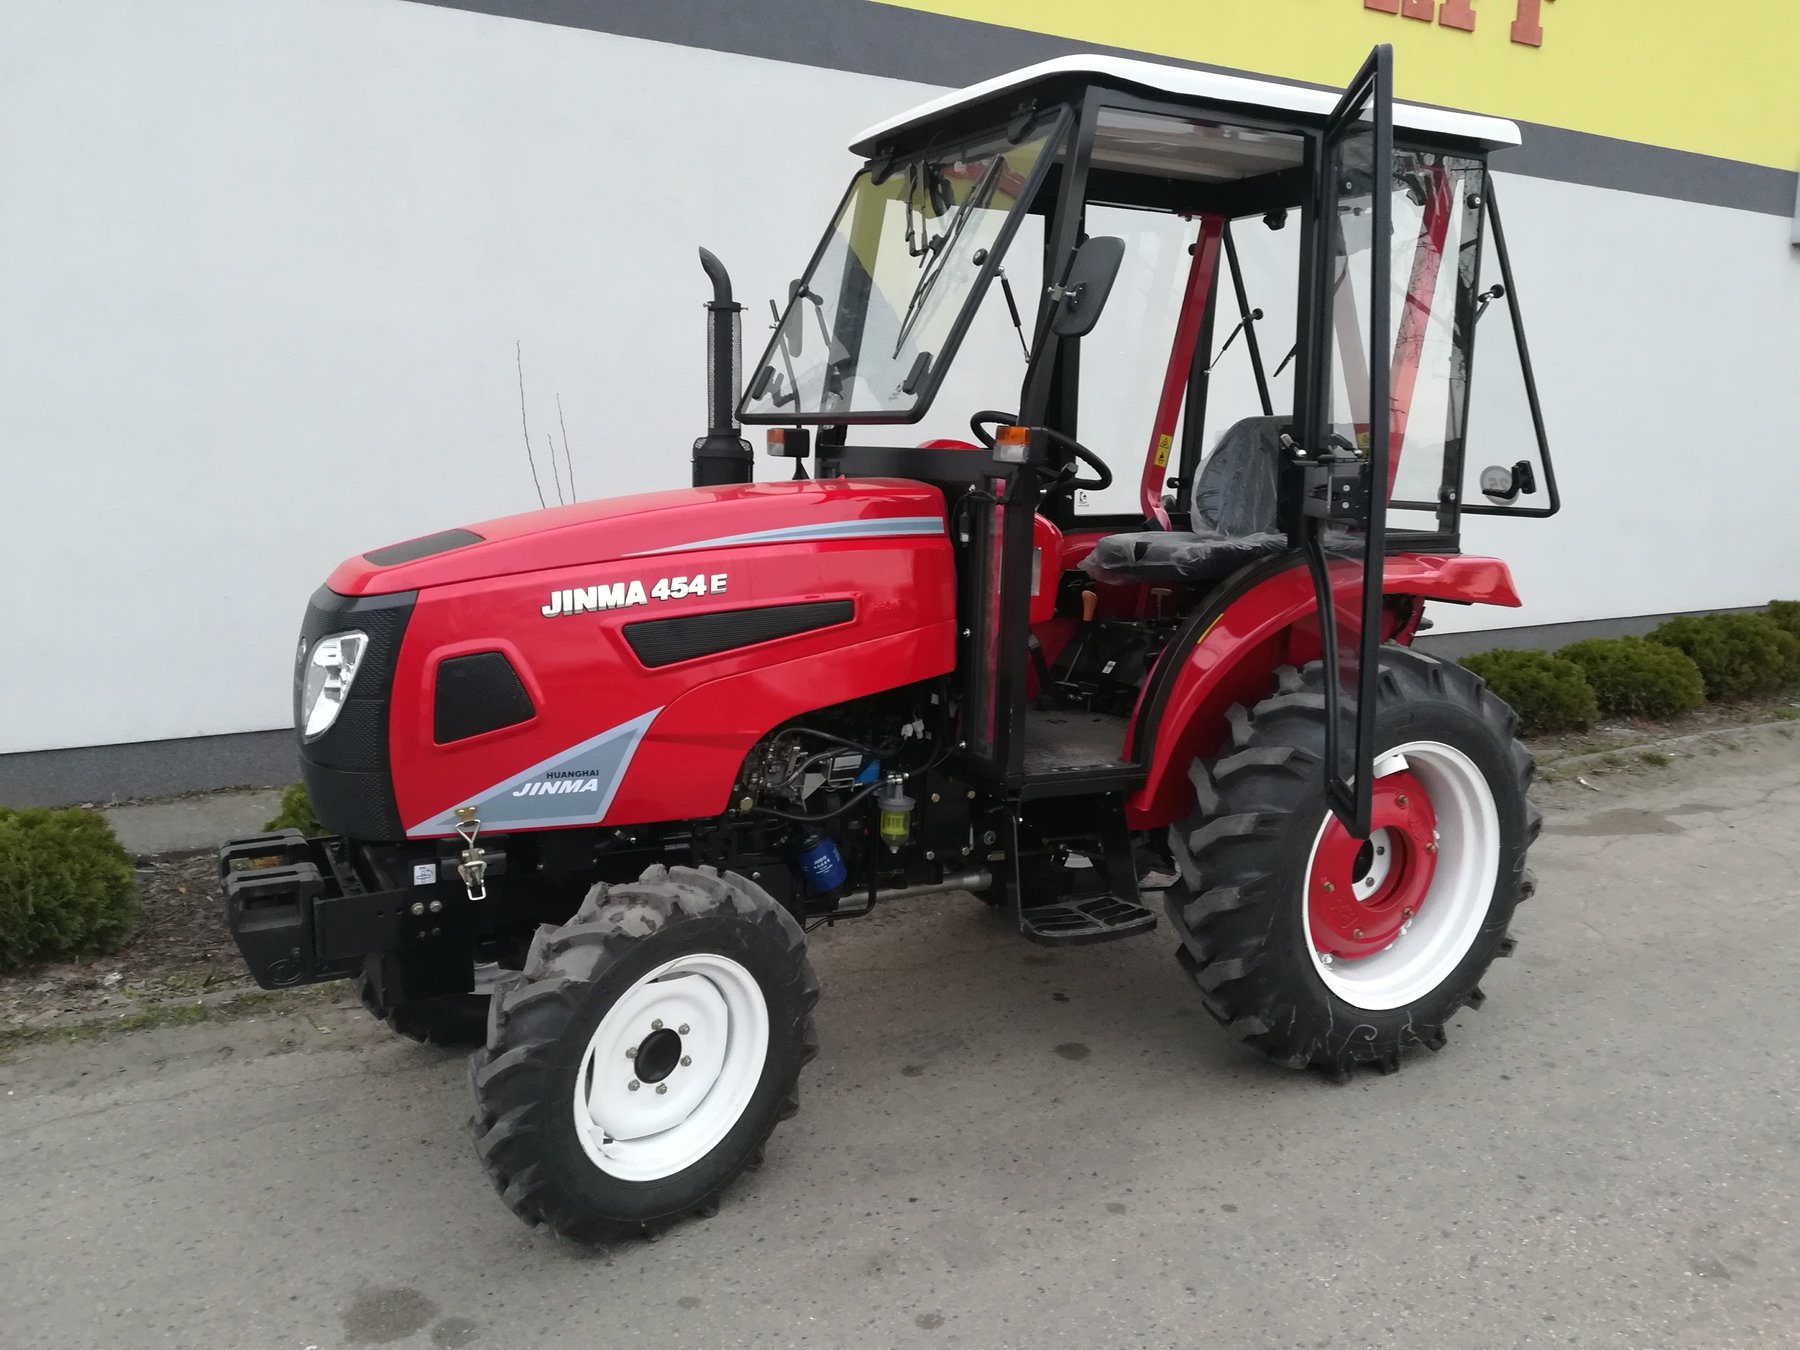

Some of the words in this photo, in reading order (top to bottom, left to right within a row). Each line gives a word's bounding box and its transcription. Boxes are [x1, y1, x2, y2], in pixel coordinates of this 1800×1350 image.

[541, 580, 648, 617] JINMA
[651, 574, 707, 601] 454
[710, 573, 728, 595] E
[546, 769, 600, 779] HUANGHAI
[512, 778, 599, 797] JINMA
